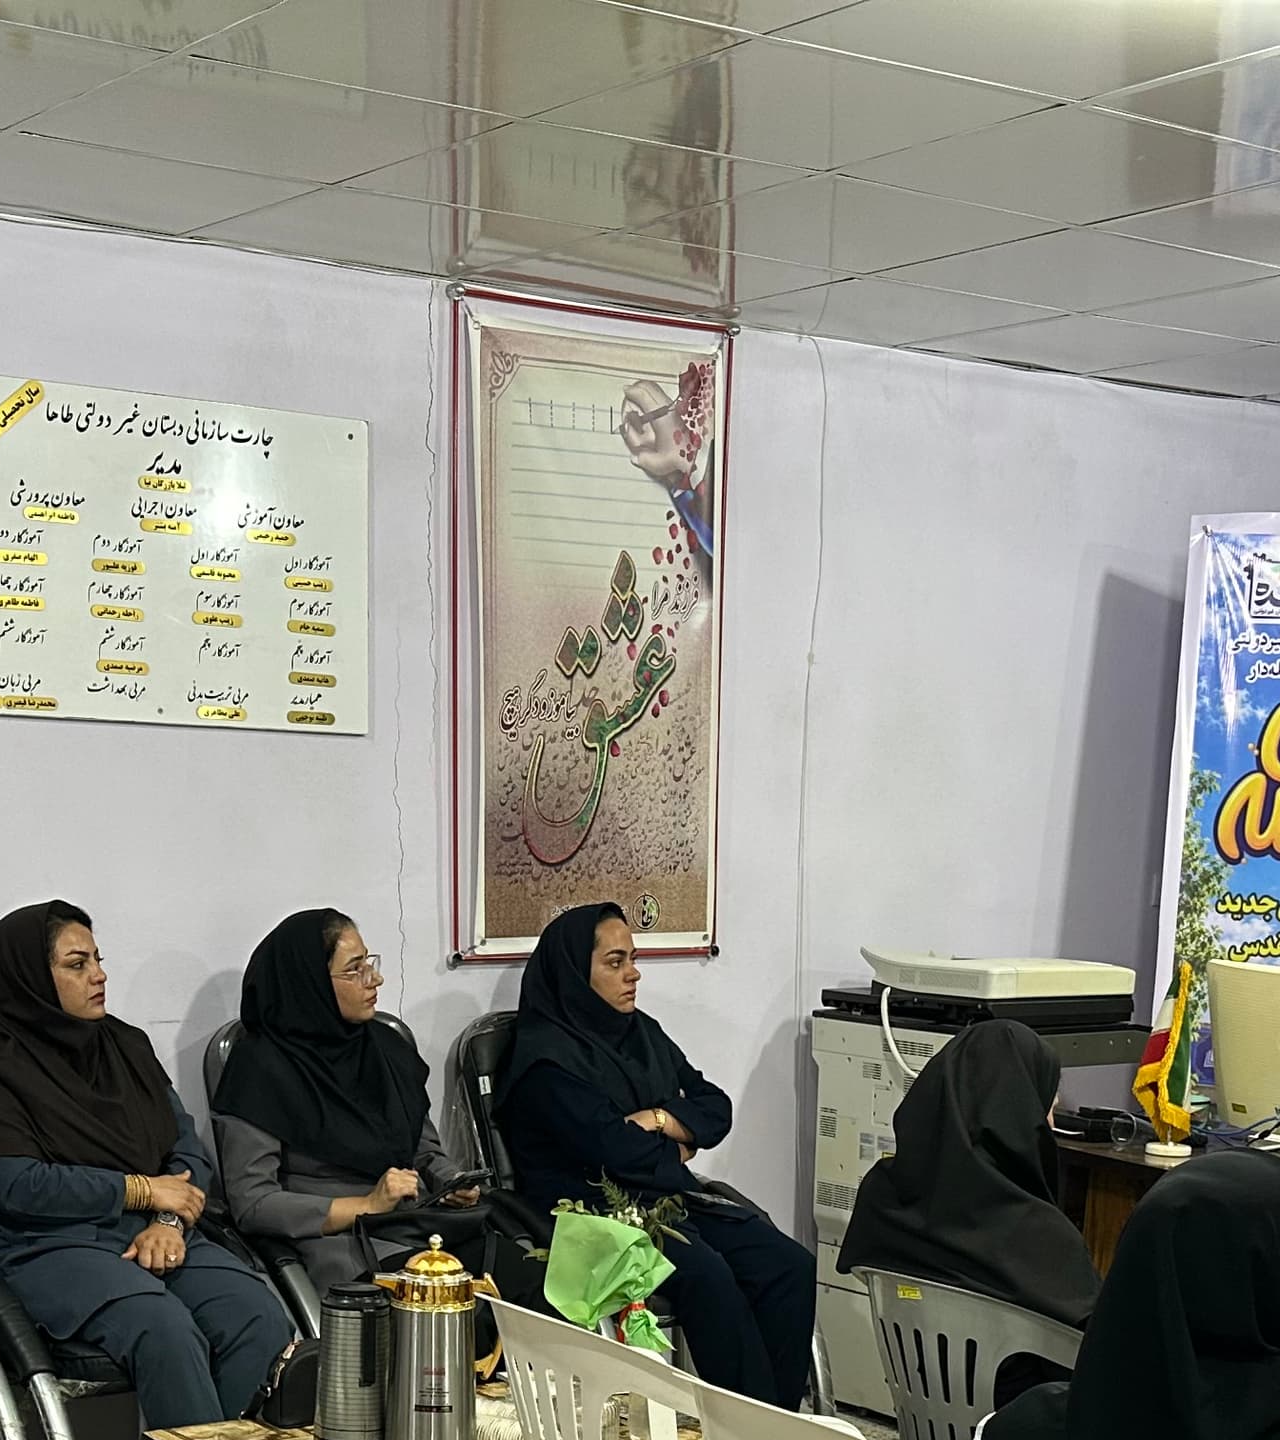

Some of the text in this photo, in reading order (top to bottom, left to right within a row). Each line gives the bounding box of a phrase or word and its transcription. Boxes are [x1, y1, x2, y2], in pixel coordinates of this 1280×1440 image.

[76, 402, 112, 433] دولتی
[113, 402, 141, 436] غیر
[142, 415, 183, 437] دبستان
[186, 409, 229, 445] سازمانی
[231, 427, 274, 459] چارت
[145, 451, 182, 475] مدیر
[10, 478, 86, 508] معاون پرورشی
[131, 495, 197, 519] معاون اجرایی
[237, 502, 304, 530] معاون آموزشی
[11, 527, 44, 545] آموزگار
[93, 534, 144, 555] آموزگار دوم
[190, 547, 240, 565] آموزگار اول
[284, 555, 333, 573] آموزگار اول
[12, 576, 46, 593] آموزگار
[88, 581, 145, 602] آموزگار چهارم
[196, 590, 241, 611] آموزگار سوم
[289, 598, 332, 618] آموزگار سوم
[15, 628, 48, 645] آموزگار
[98, 625, 146, 662] آموزگار ششم
[198, 632, 241, 665] آموزگار پنجم
[291, 639, 333, 671] آموزگار پنجم
[86, 676, 127, 697] بهداشت
[204, 686, 233, 702] تربیت
[523, 550, 677, 865] عشق
[1215, 892, 1278, 922] جدید
